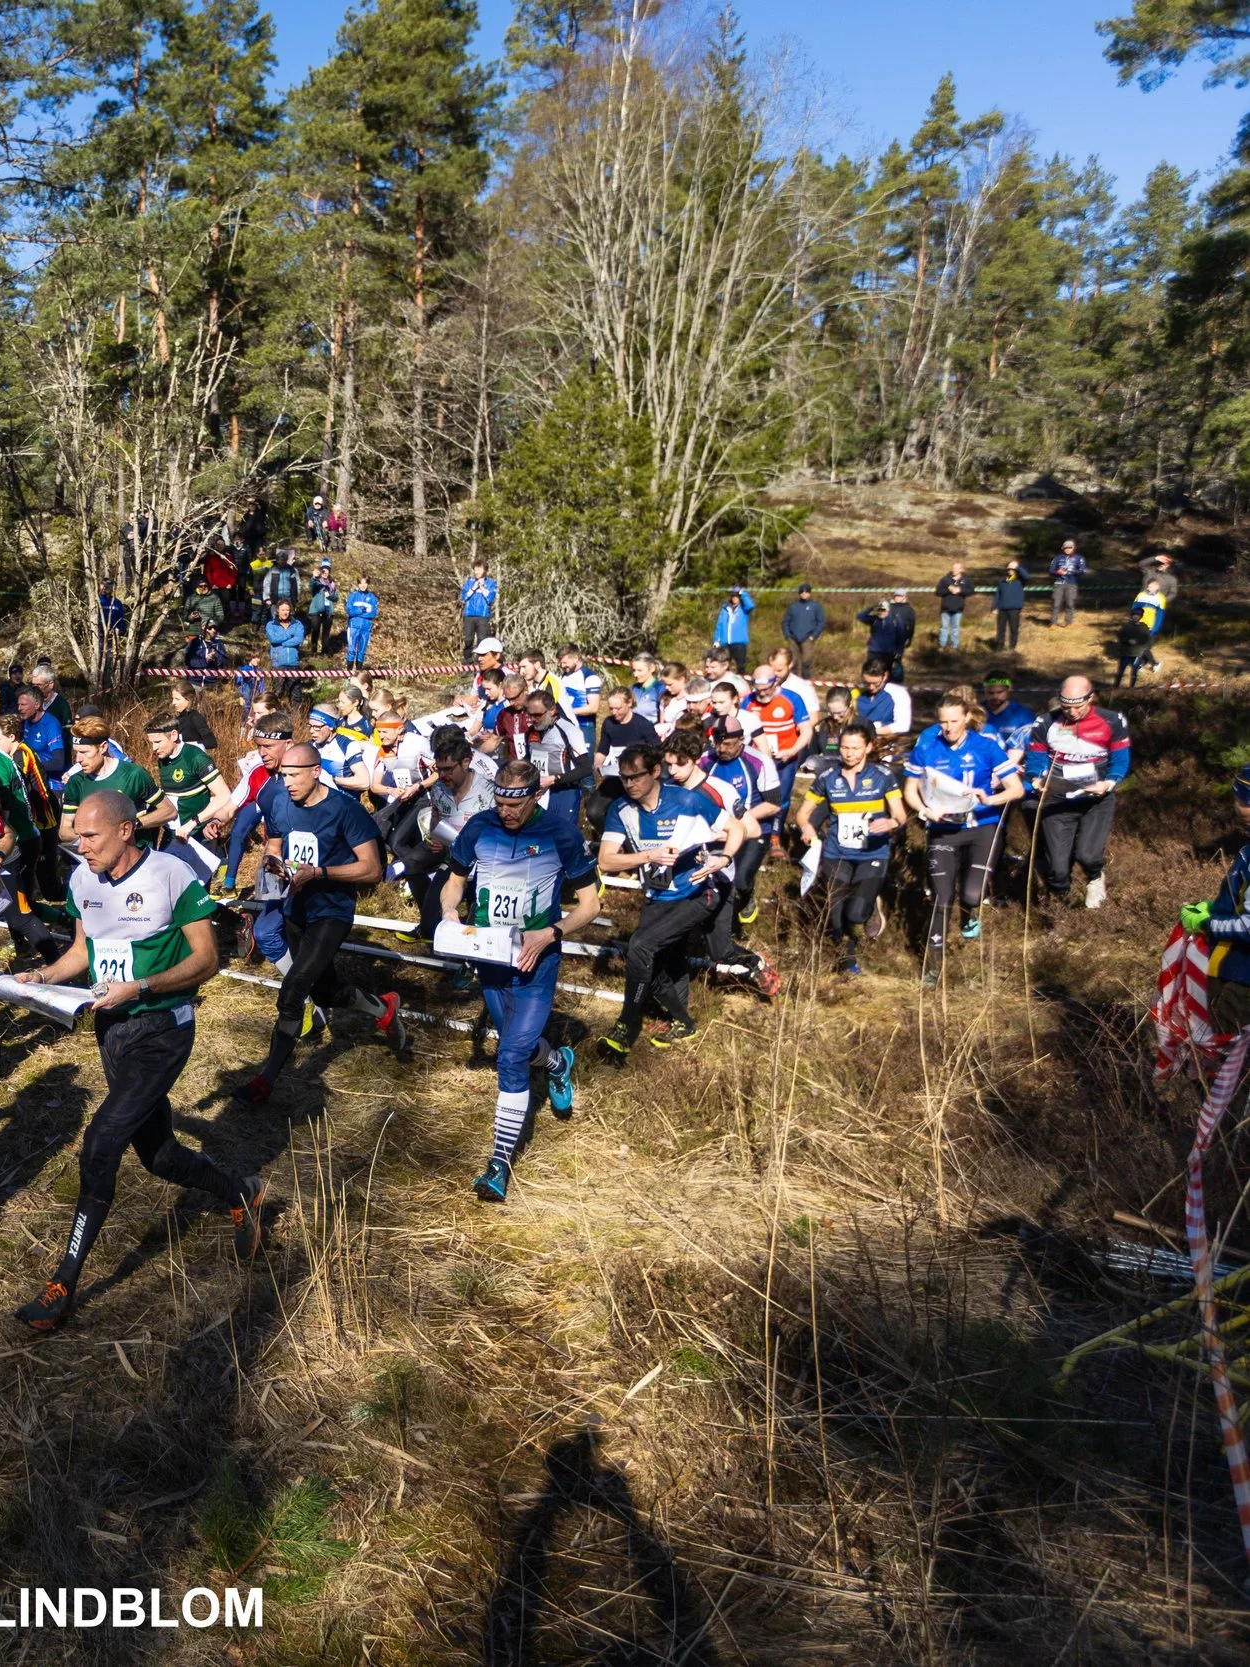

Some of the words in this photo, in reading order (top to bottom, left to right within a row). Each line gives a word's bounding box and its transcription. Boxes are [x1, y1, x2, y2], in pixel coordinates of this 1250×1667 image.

[293, 844, 314, 866] 242
[493, 894, 518, 919] 231
[99, 959, 127, 982] 221
[68, 1211, 88, 1259] TRIMTEX
